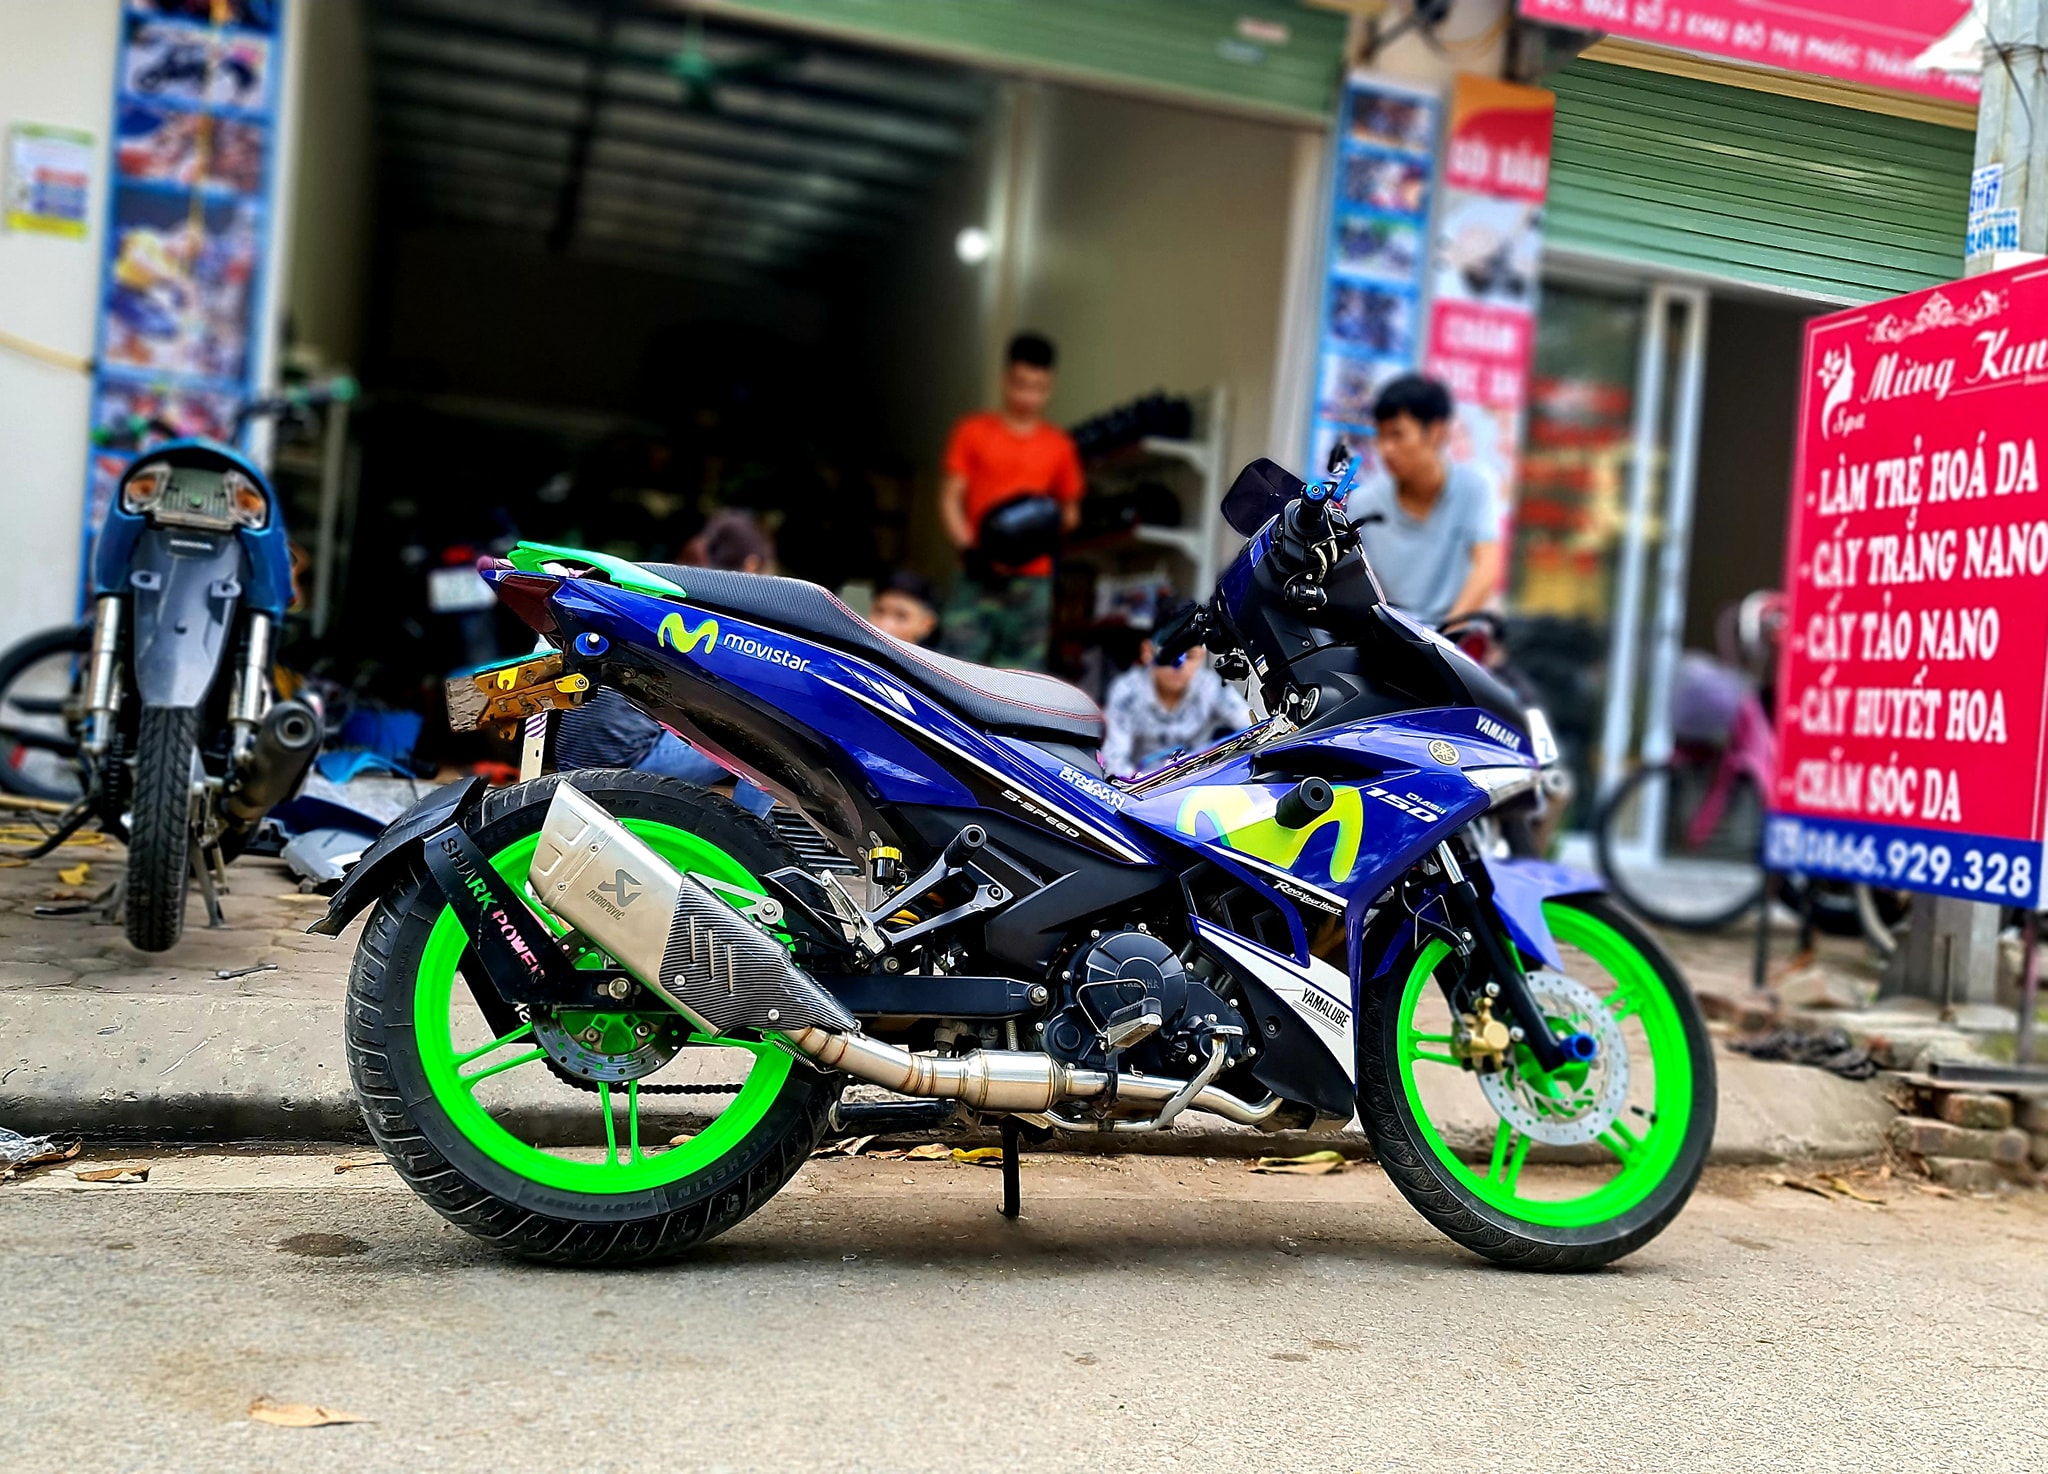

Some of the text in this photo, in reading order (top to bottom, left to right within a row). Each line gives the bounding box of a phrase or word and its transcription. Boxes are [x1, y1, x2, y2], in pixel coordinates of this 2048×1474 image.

[1832, 407, 1866, 437] Spa
[1818, 430, 2038, 515] LÀM TRẺ HOÁ DA
[1813, 507, 2048, 589] CẤY TRẮNG NANO
[723, 633, 811, 672] movistar
[1807, 592, 1857, 662] CẤY
[1918, 607, 2000, 661] NANO
[1475, 714, 1521, 751] YAMAHA
[1801, 665, 2007, 744] CẤY HUYẾT HOA
[1366, 787, 1439, 823] 150
[1867, 752, 1917, 817] SÓC
[1921, 769, 1962, 823] DA
[441, 837, 498, 911] SHARK
[491, 908, 546, 984] POWER
[1301, 987, 1350, 1029] YAMALUBE
